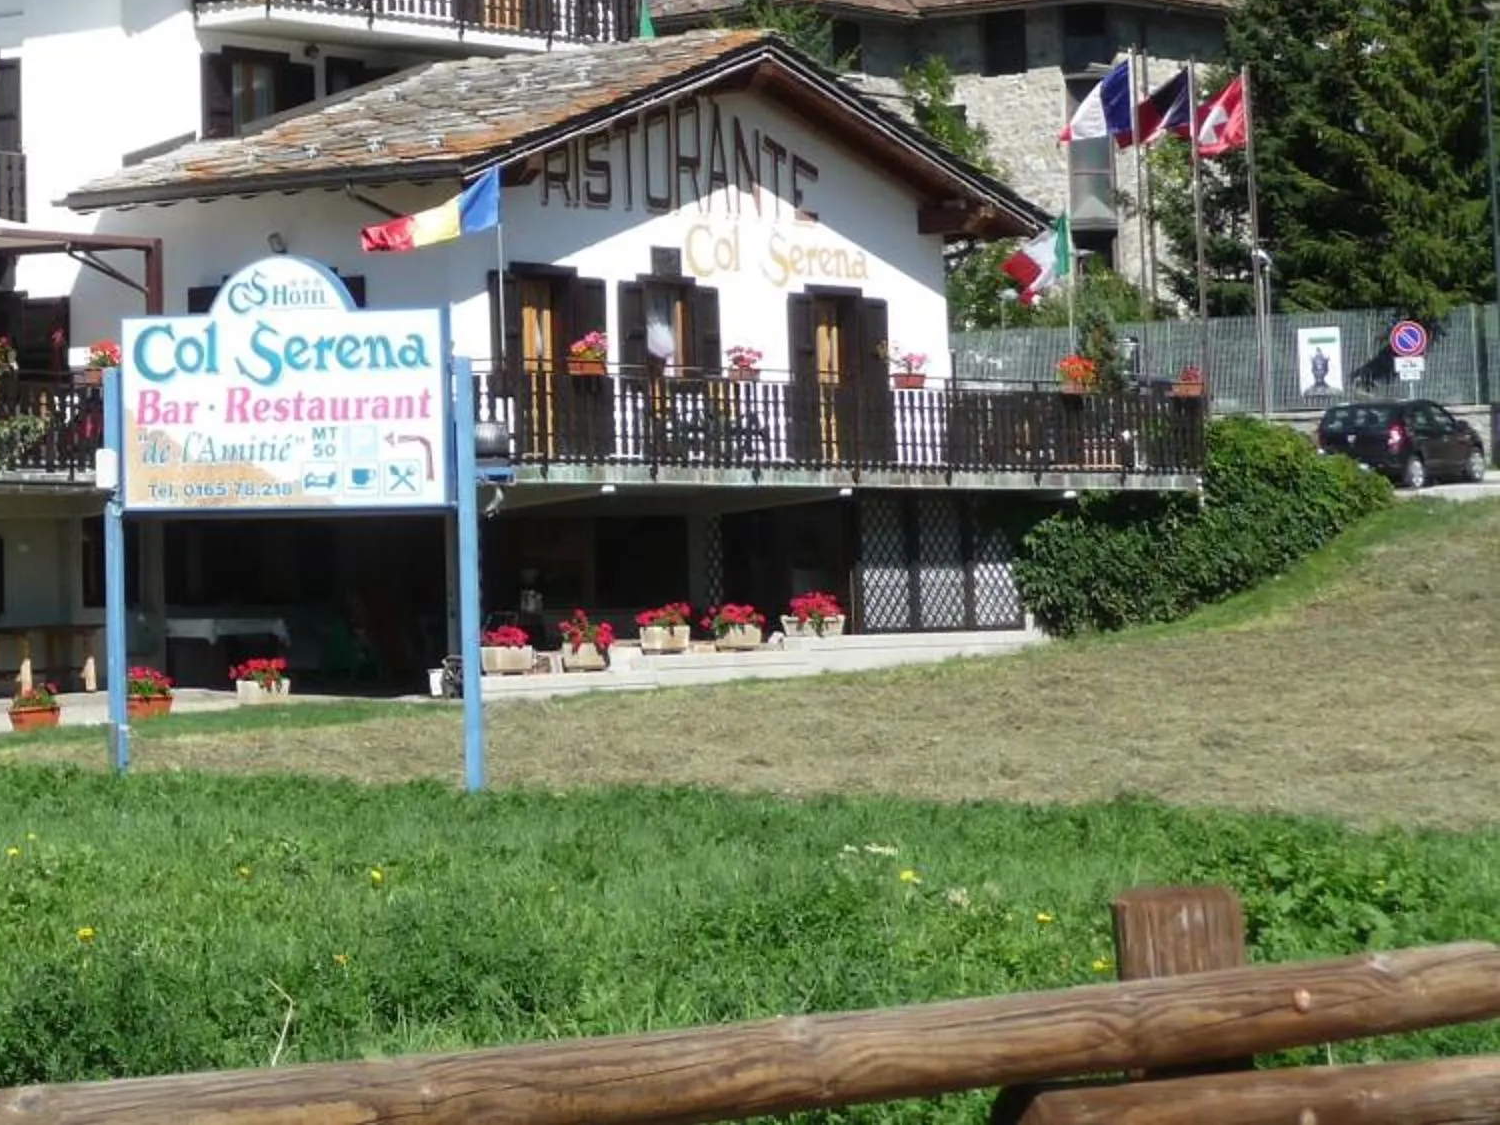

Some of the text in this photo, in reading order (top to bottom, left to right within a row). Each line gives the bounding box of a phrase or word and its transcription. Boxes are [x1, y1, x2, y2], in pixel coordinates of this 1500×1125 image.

[540, 95, 819, 226] RISTORANTE
[685, 224, 870, 287] Col Serena
[133, 320, 432, 387] Col Serena
[136, 385, 432, 426] Bar Restaurant
[312, 426, 339, 441] MT
[312, 444, 337, 457] 50
[183, 482, 228, 497] 0165
